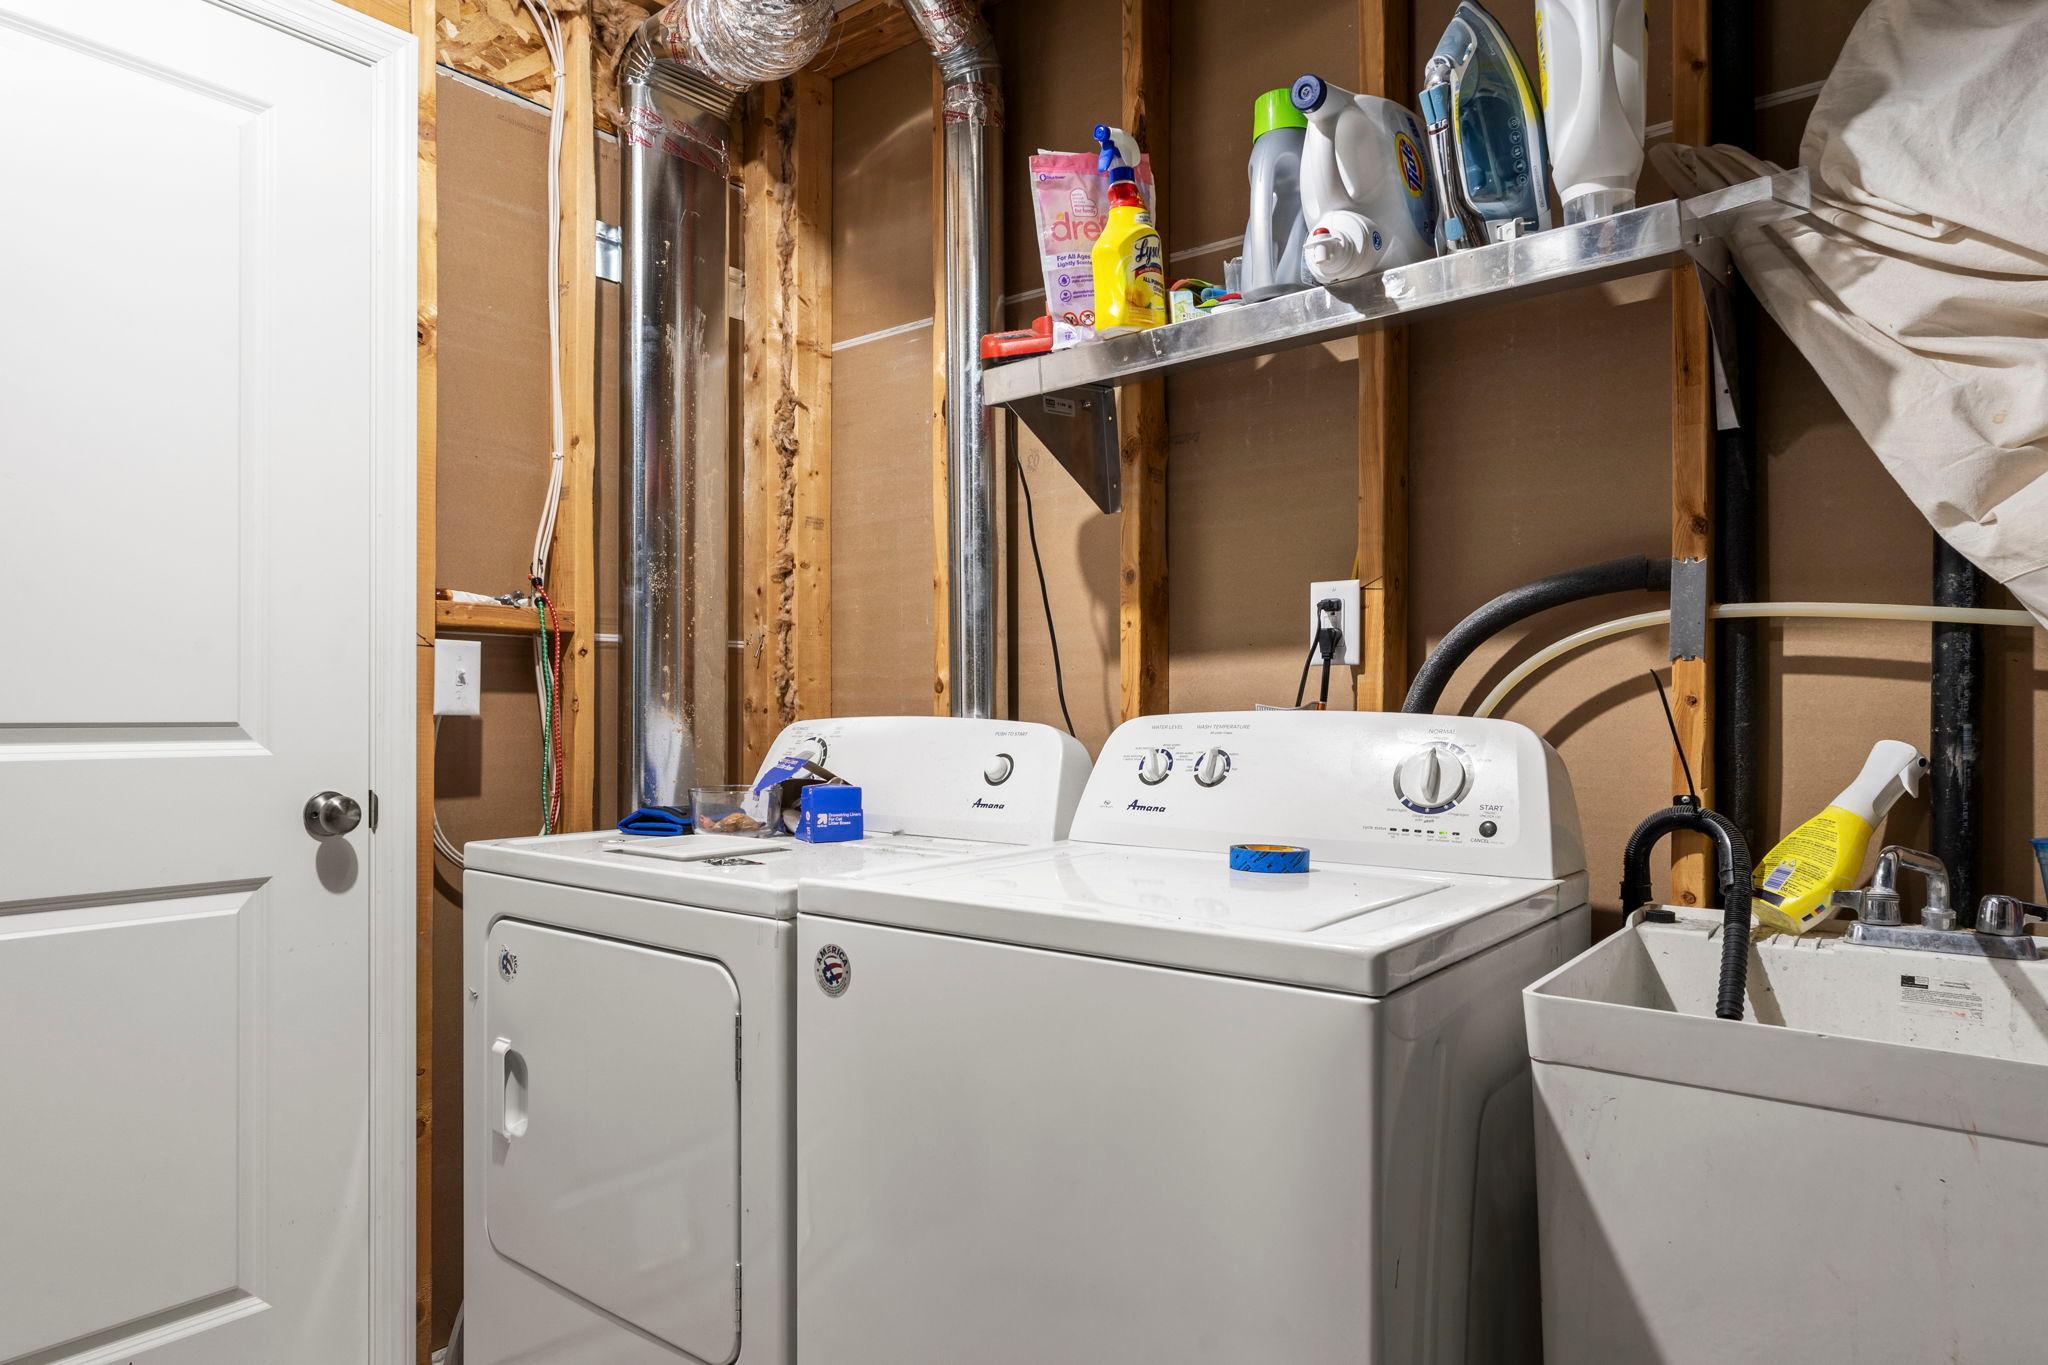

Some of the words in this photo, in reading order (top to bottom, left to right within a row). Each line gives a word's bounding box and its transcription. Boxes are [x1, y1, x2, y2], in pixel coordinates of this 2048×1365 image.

[1402, 139, 1423, 192] Tide
[972, 798, 1005, 810] Amana
[1126, 799, 1166, 812] Amana
[817, 945, 848, 967] AMERICA
